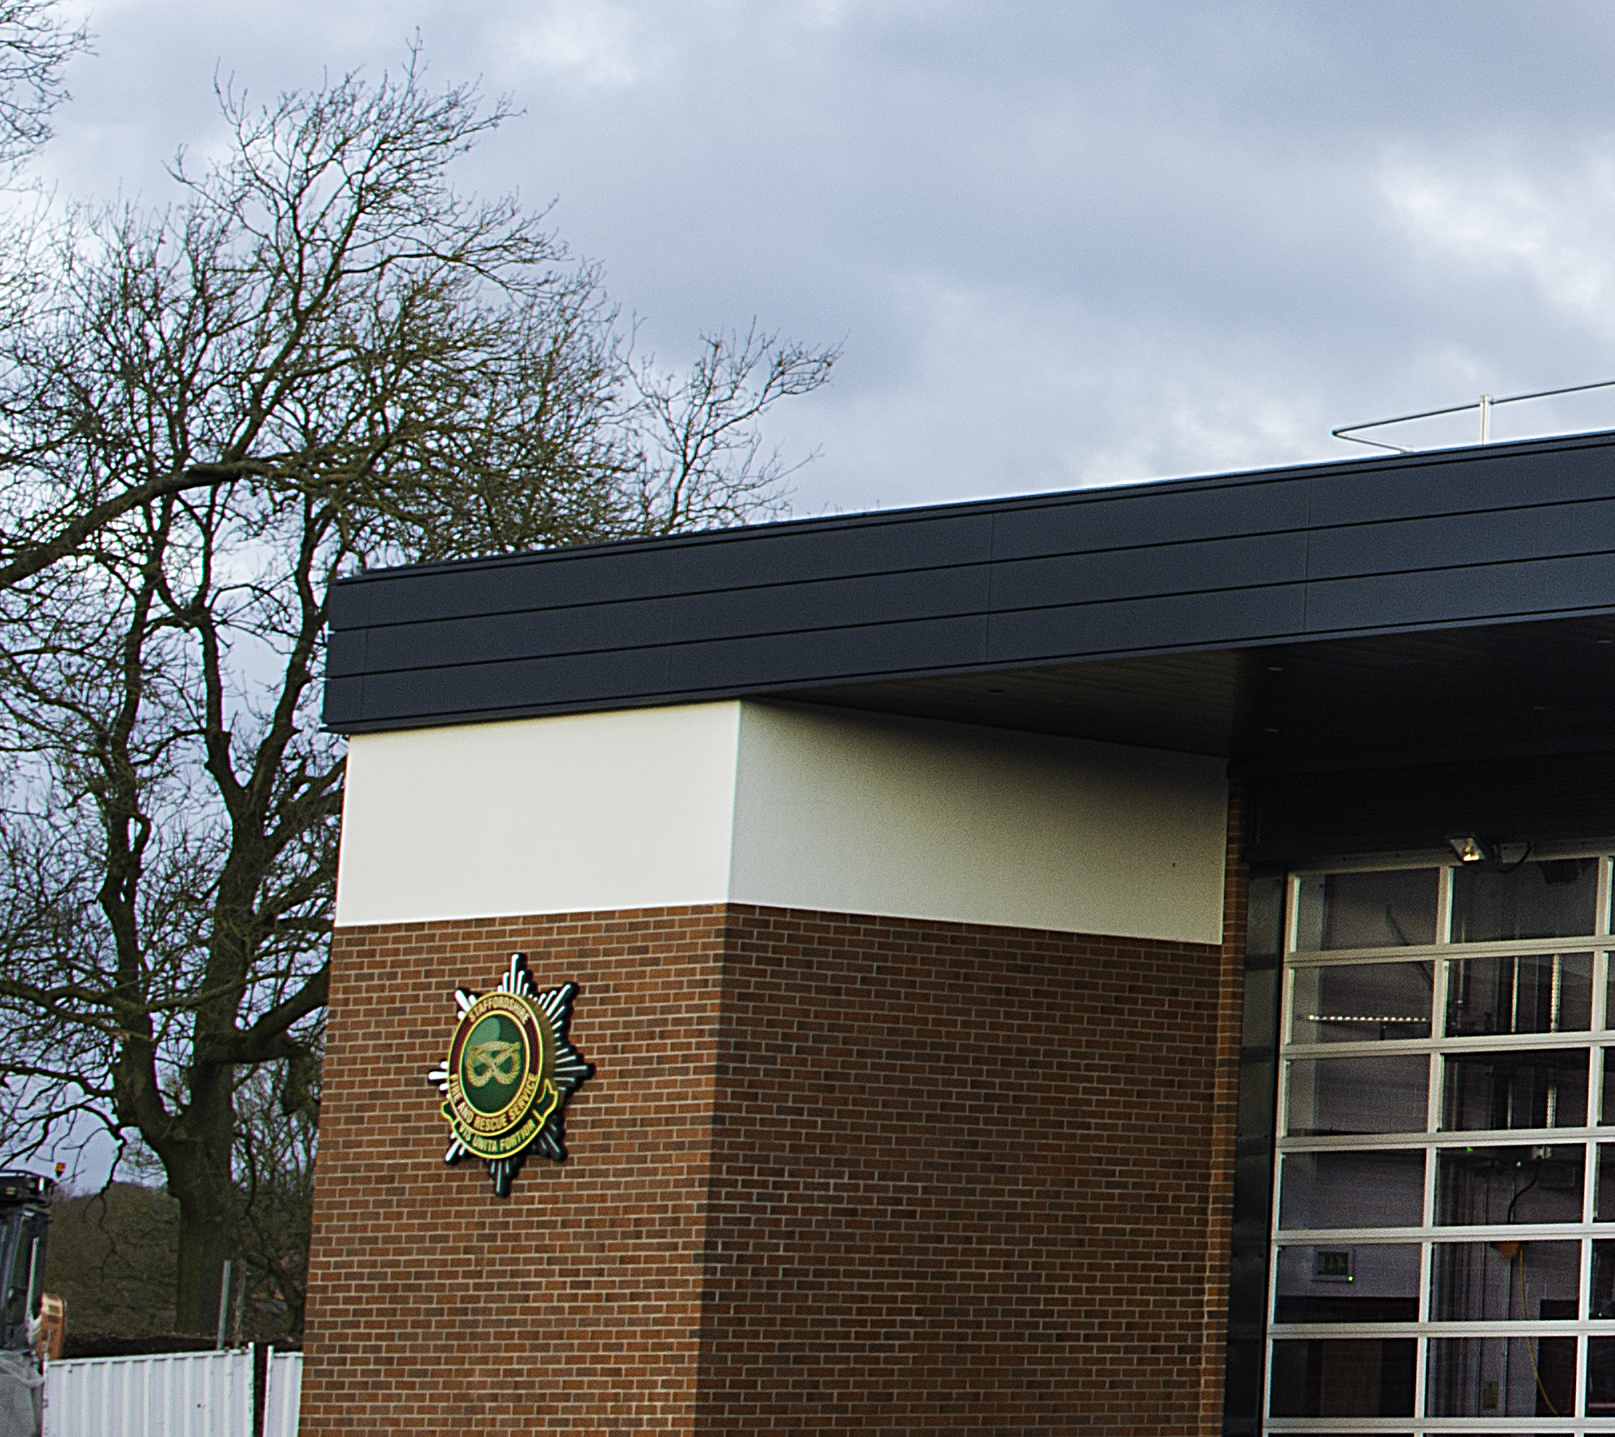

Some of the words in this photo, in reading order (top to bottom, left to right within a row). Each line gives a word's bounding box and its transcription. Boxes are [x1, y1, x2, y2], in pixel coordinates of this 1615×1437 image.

[468, 996, 530, 1024] STAFFORDSHIRE
[450, 1074, 463, 1103] FIRE
[458, 1102, 475, 1124] AND
[474, 1115, 508, 1131] RESCUE
[509, 1073, 538, 1120] SERVICE
[472, 1136, 499, 1152] UNITA
